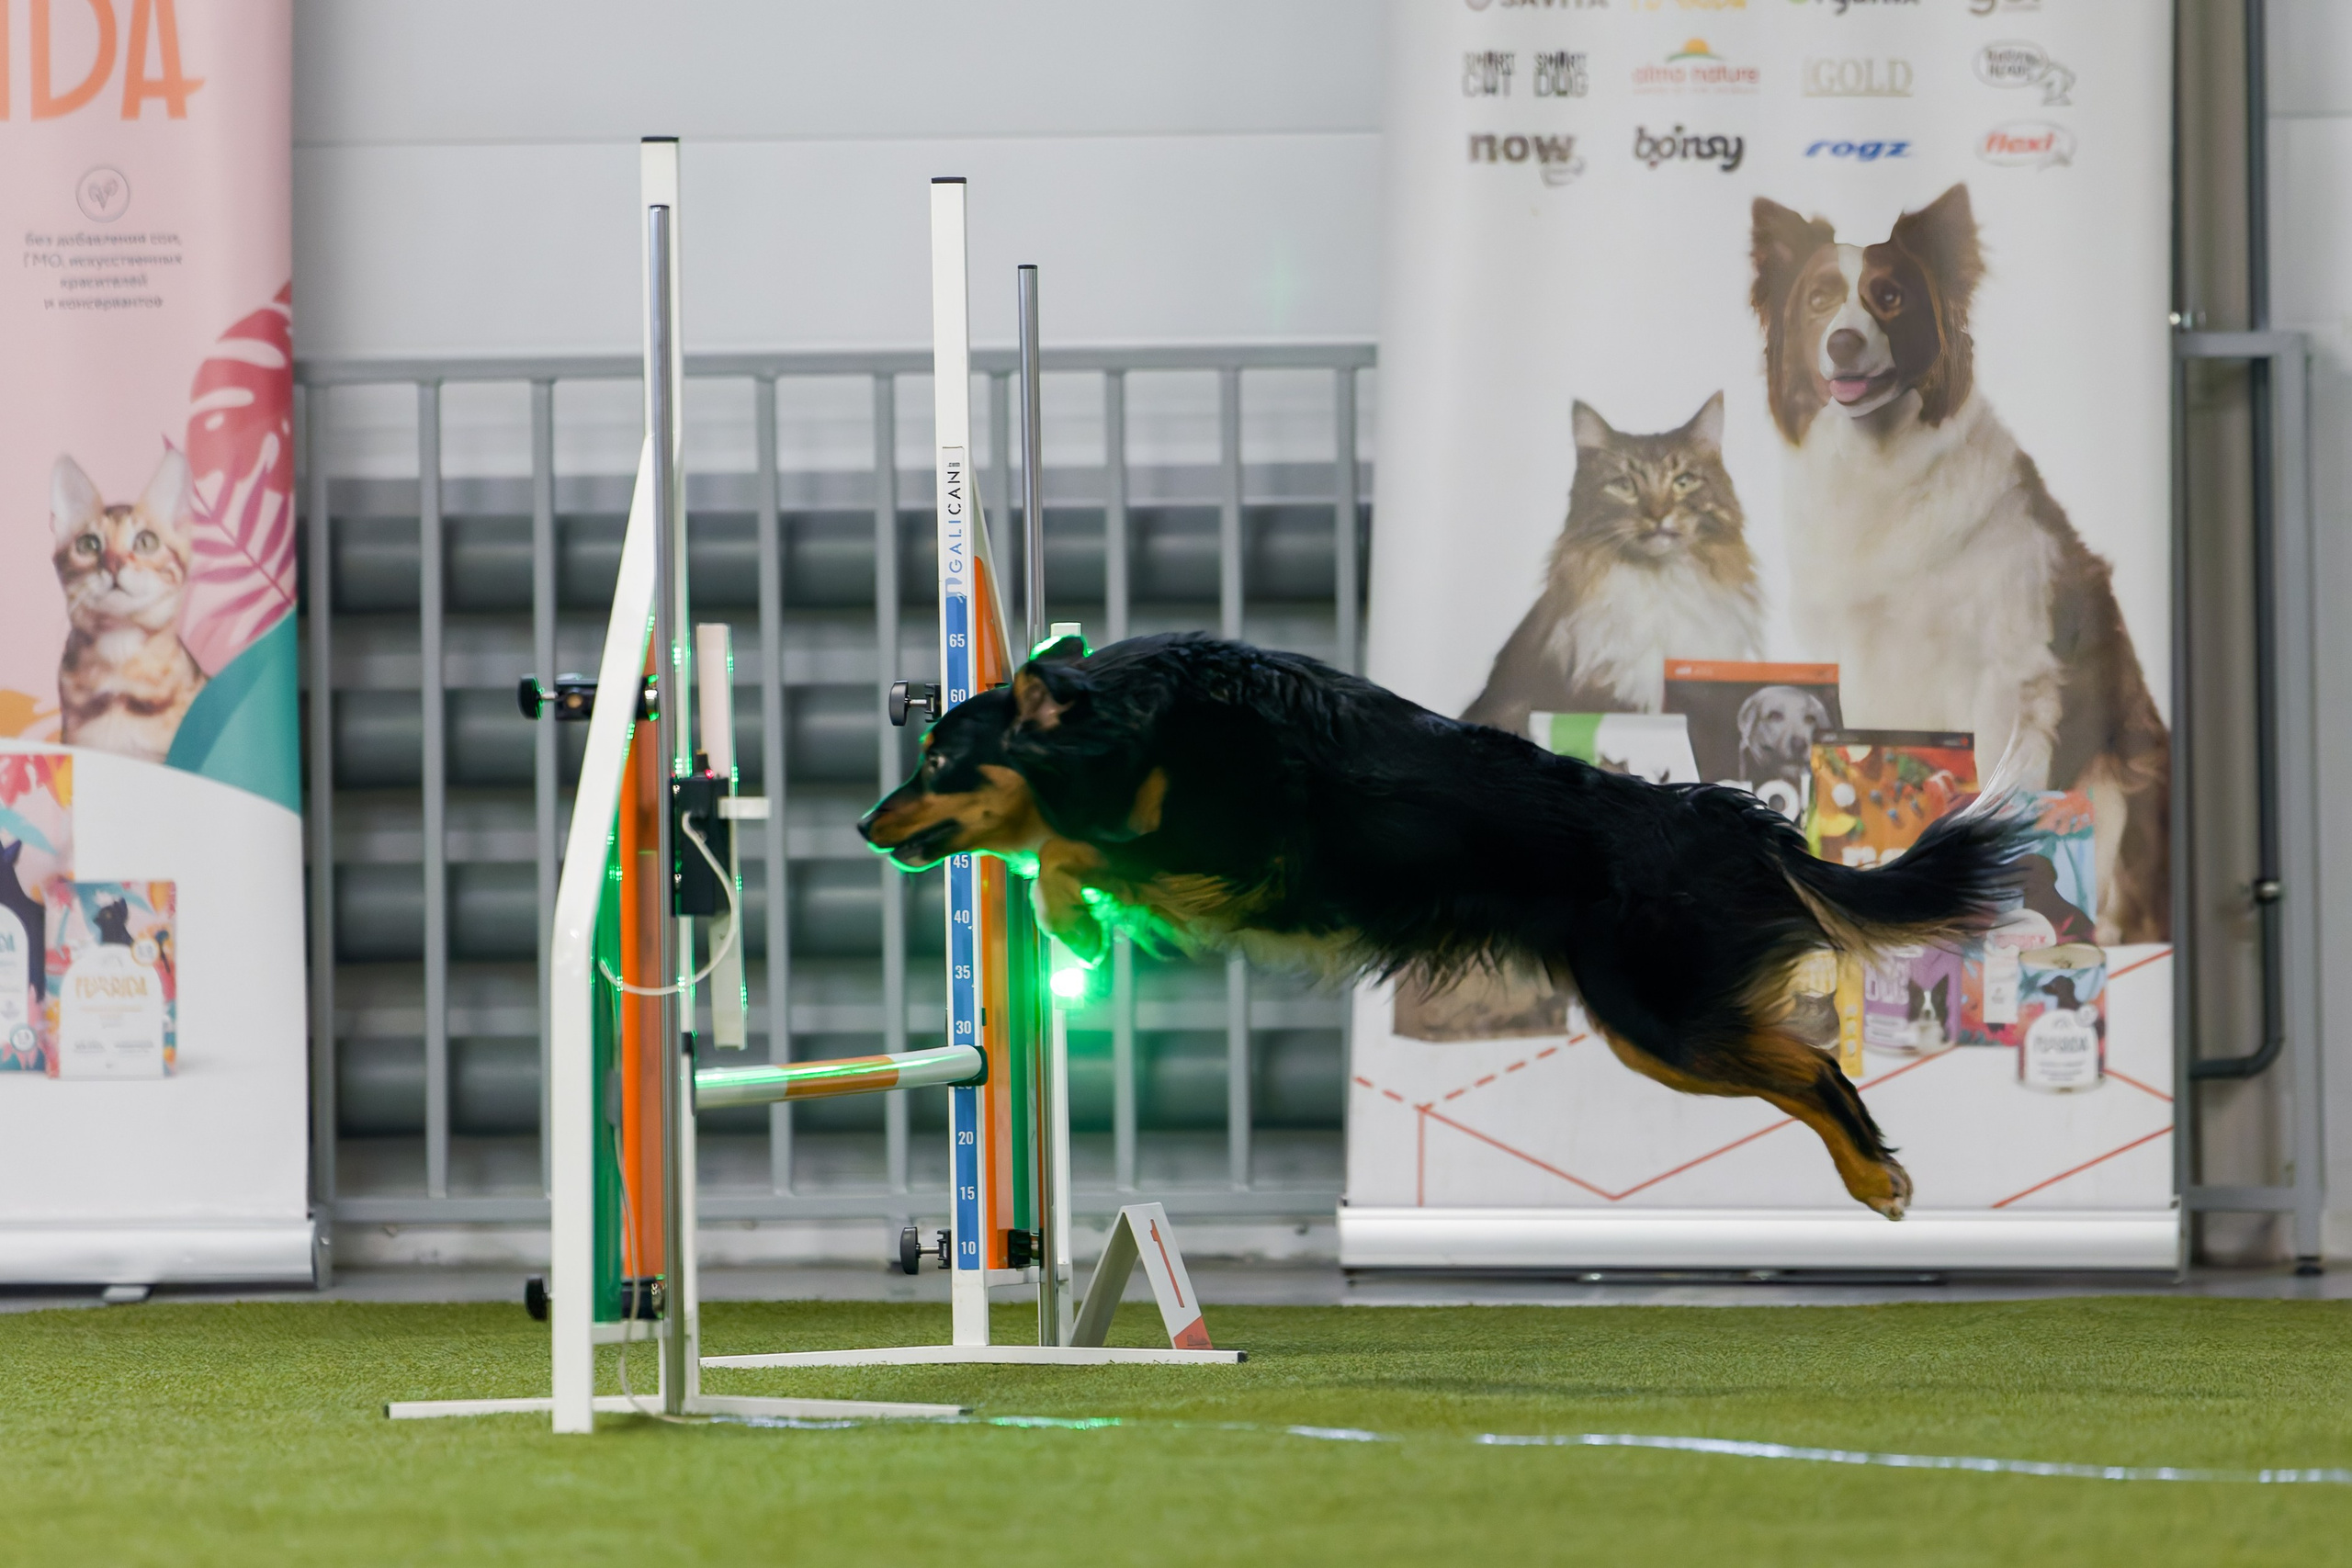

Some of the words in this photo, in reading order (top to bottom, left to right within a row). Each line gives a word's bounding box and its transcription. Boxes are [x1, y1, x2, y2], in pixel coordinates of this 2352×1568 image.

[1813, 57, 1914, 92] GOLD
[1469, 134, 1576, 164] now
[1804, 141, 1912, 162] rogz
[947, 471, 963, 573] GALICAN
[949, 634, 966, 648] 65
[950, 689, 967, 704] 60
[953, 854, 968, 868] 45
[954, 909, 970, 923] 40
[955, 965, 971, 979] 35
[956, 1021, 972, 1034] 30
[958, 1131, 974, 1145] 20
[960, 1186, 975, 1201] 15
[961, 1241, 976, 1255] 10
